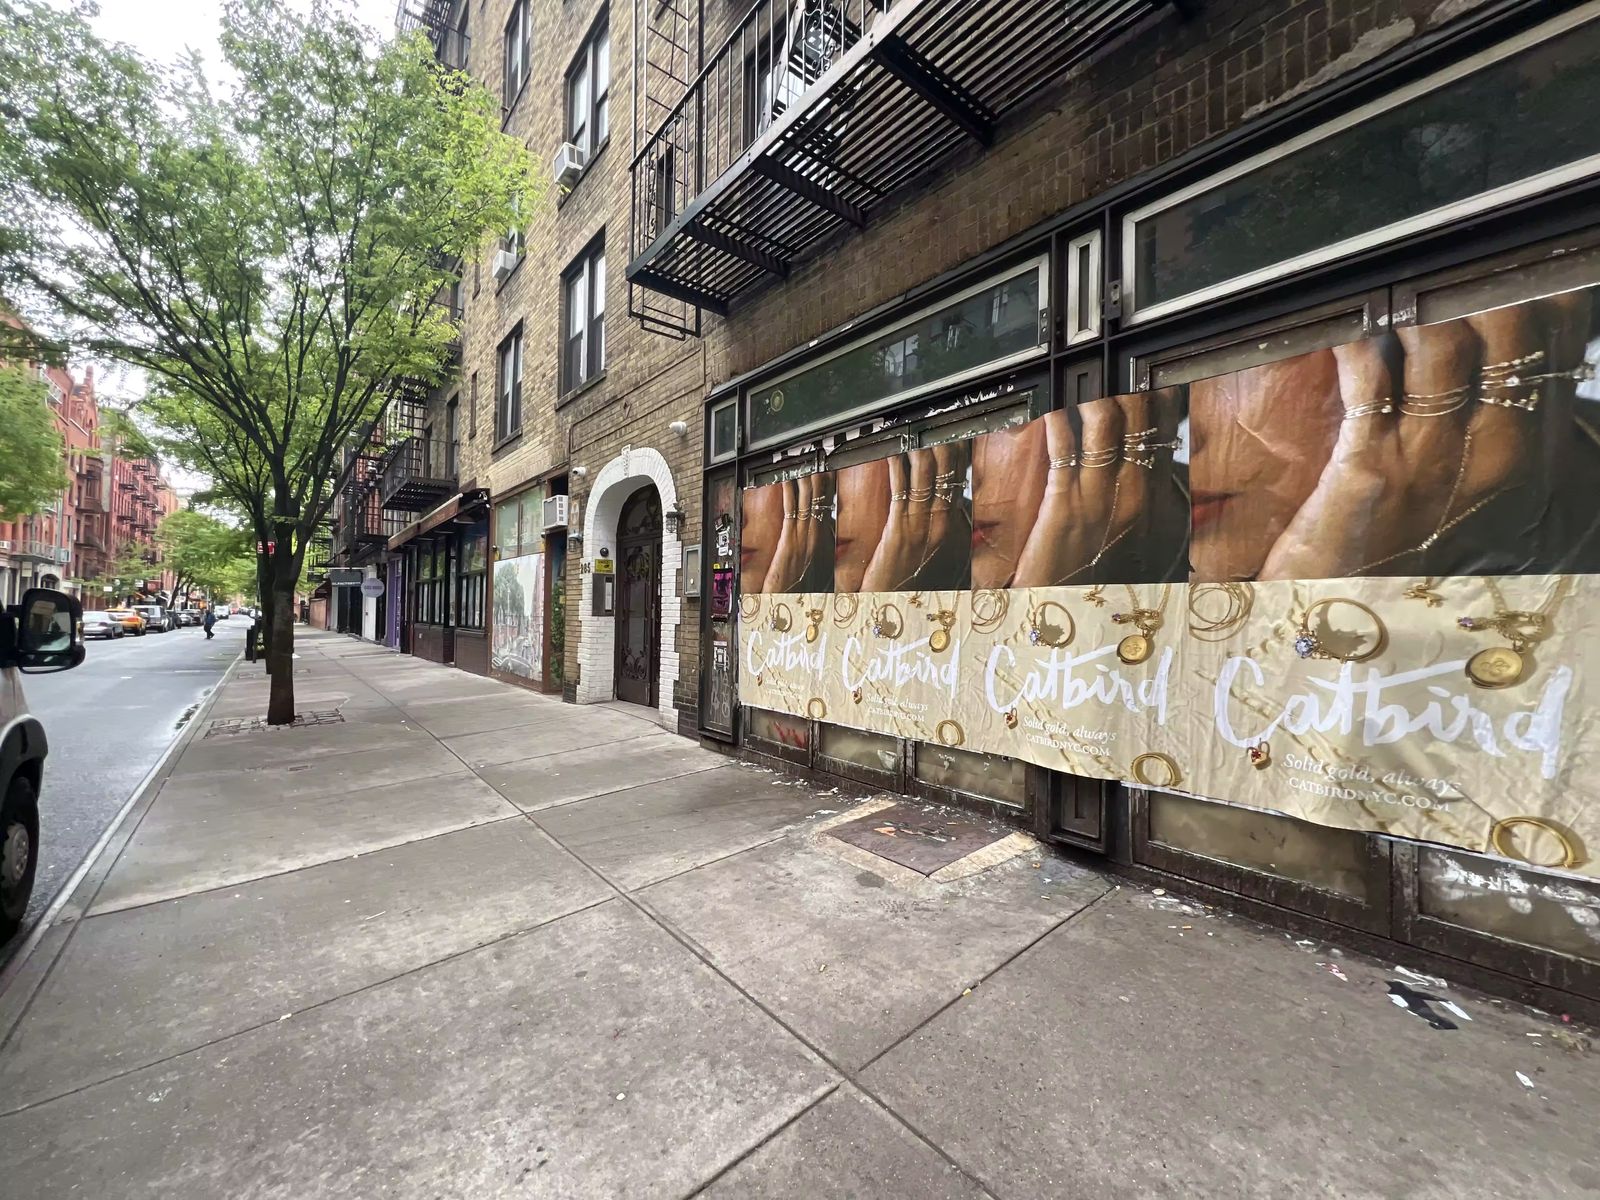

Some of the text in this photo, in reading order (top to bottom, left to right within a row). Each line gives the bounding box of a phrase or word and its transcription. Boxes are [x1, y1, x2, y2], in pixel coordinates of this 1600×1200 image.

[746, 631, 828, 681] Catbird
[842, 636, 961, 704] Catbird
[985, 644, 1173, 726] Catbird
[1023, 716, 1044, 730] Solid
[1072, 725, 1117, 744] always
[1214, 656, 1573, 780] Catbird
[1026, 733, 1110, 756] CATBIRDNYC.COM
[1283, 753, 1462, 796] Solid gold, always
[1288, 777, 1450, 812] CATBIRDNYC.COM
